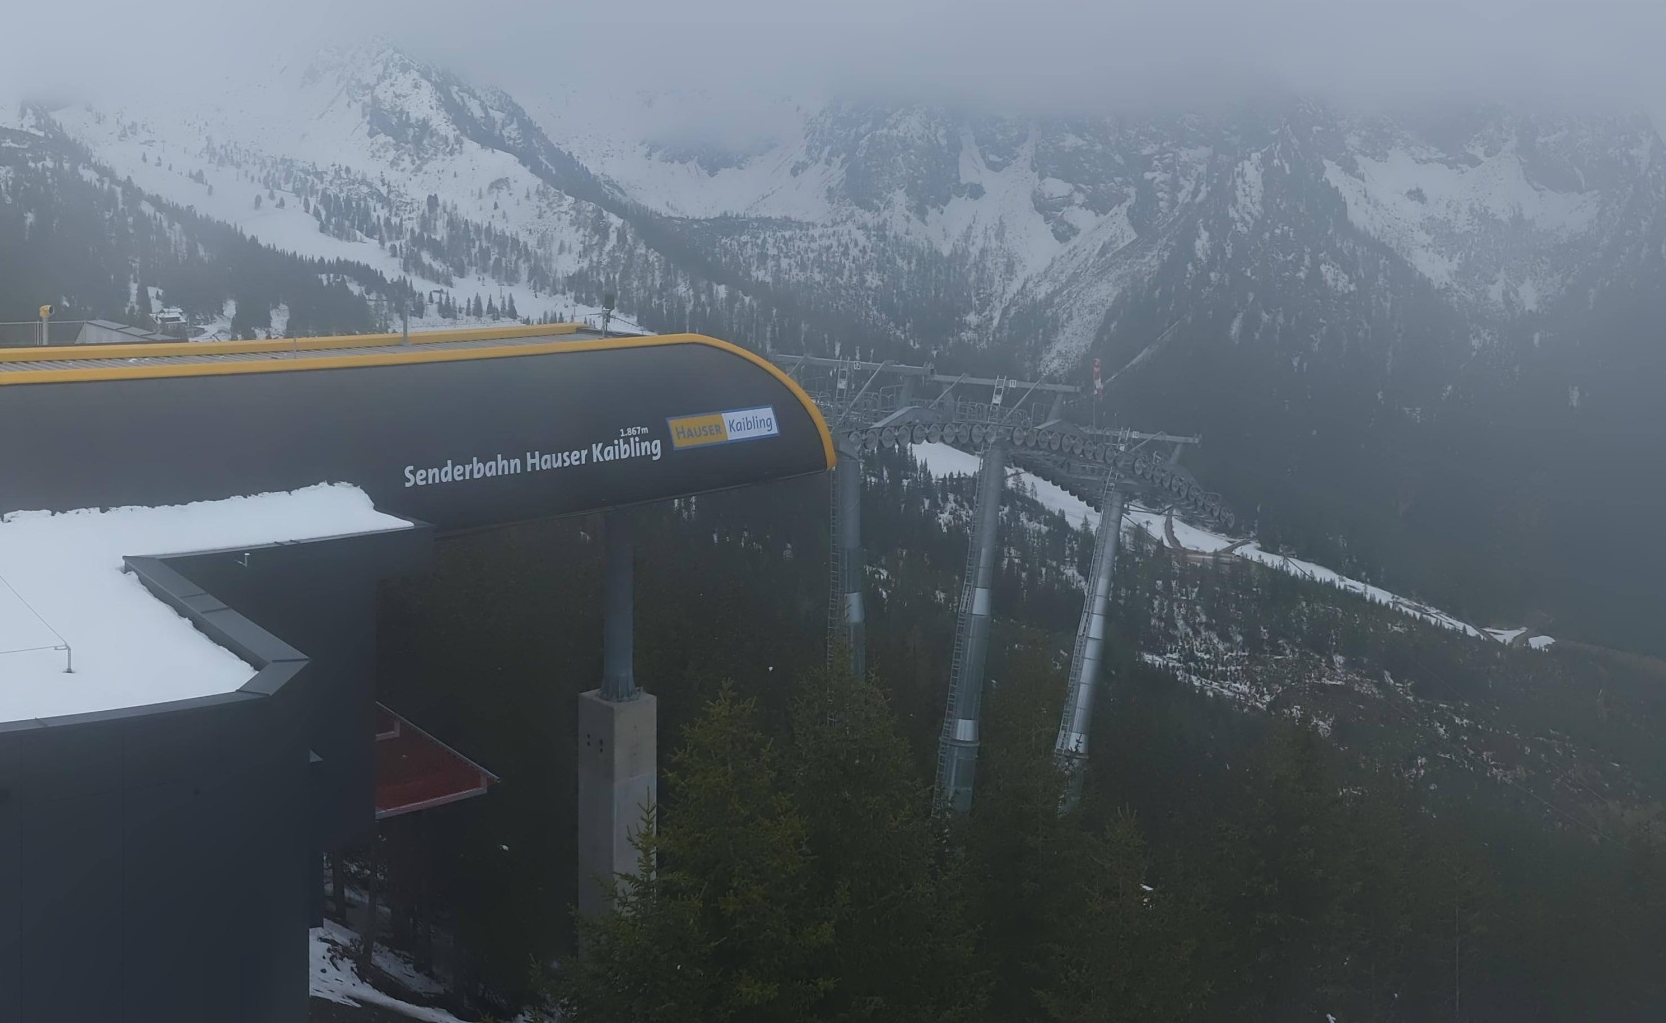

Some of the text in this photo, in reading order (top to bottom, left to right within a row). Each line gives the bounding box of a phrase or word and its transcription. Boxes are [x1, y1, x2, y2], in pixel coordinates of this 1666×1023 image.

[619, 426, 649, 437] 1.867m
[728, 415, 773, 433] Kaibling
[404, 436, 662, 487] Senderbahn Hauser Kaibling
